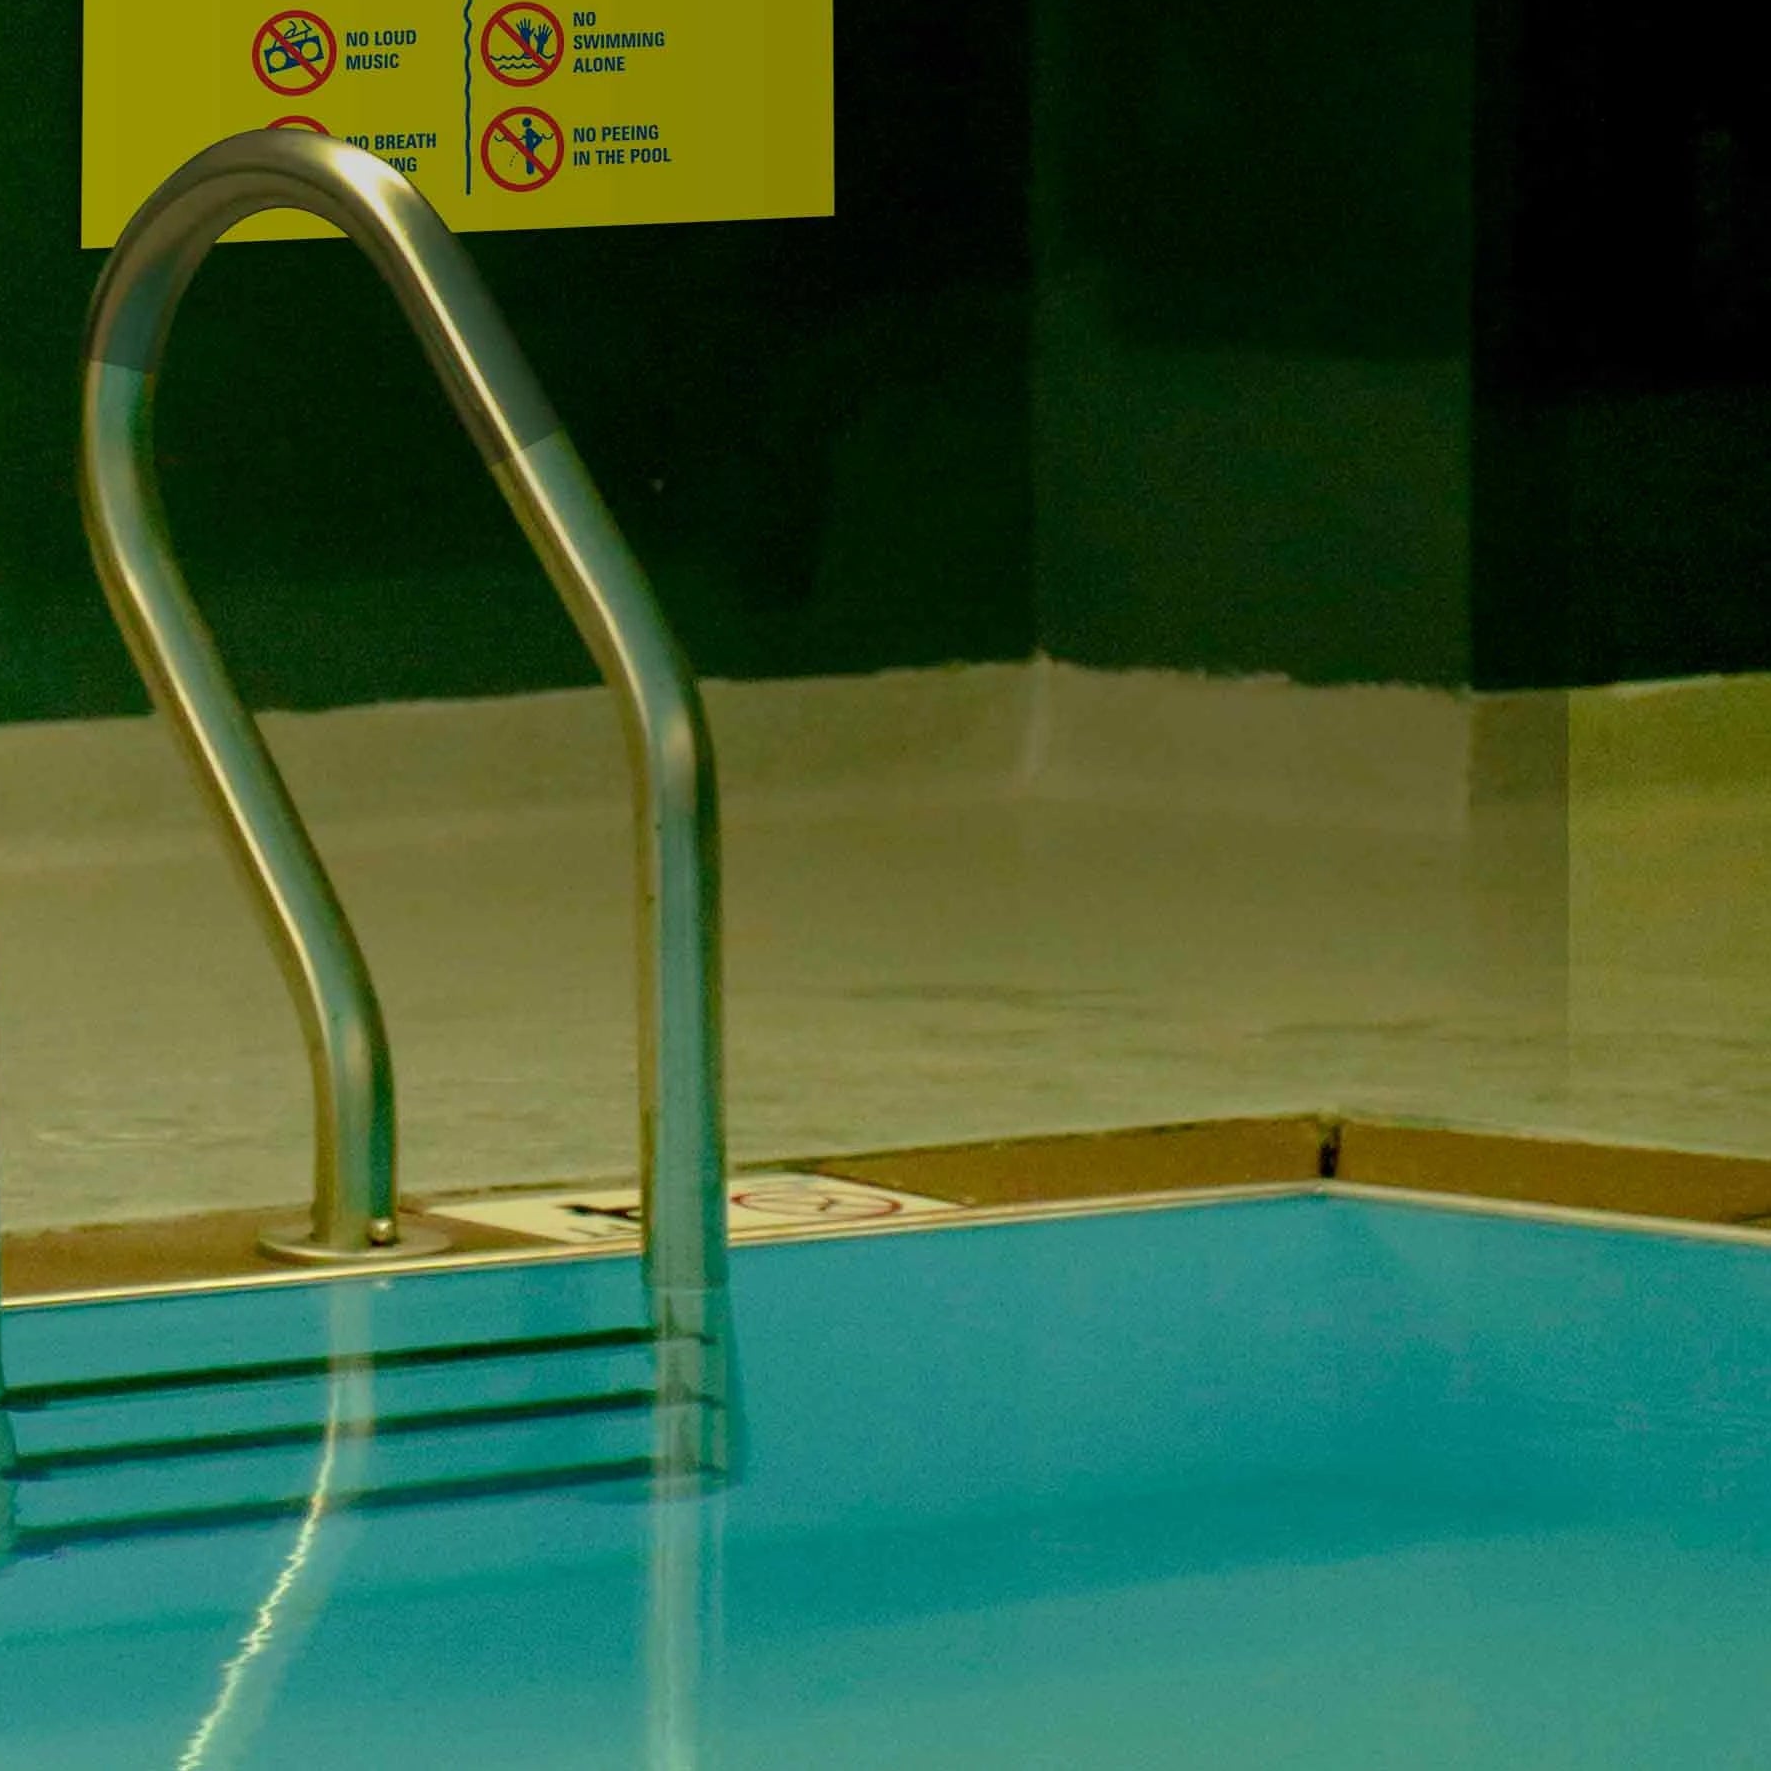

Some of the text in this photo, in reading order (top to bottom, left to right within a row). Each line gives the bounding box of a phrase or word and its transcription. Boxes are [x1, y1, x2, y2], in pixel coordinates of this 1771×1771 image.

[574, 12, 596, 26] NO
[347, 30, 416, 46] NO LOUD
[574, 32, 665, 49] SWIMMING
[346, 53, 399, 70] MUSIC
[573, 56, 625, 72] ALONE
[375, 133, 436, 150] BREATH
[574, 125, 658, 142] NO PEEING
[574, 148, 671, 165] IN THE POOL
